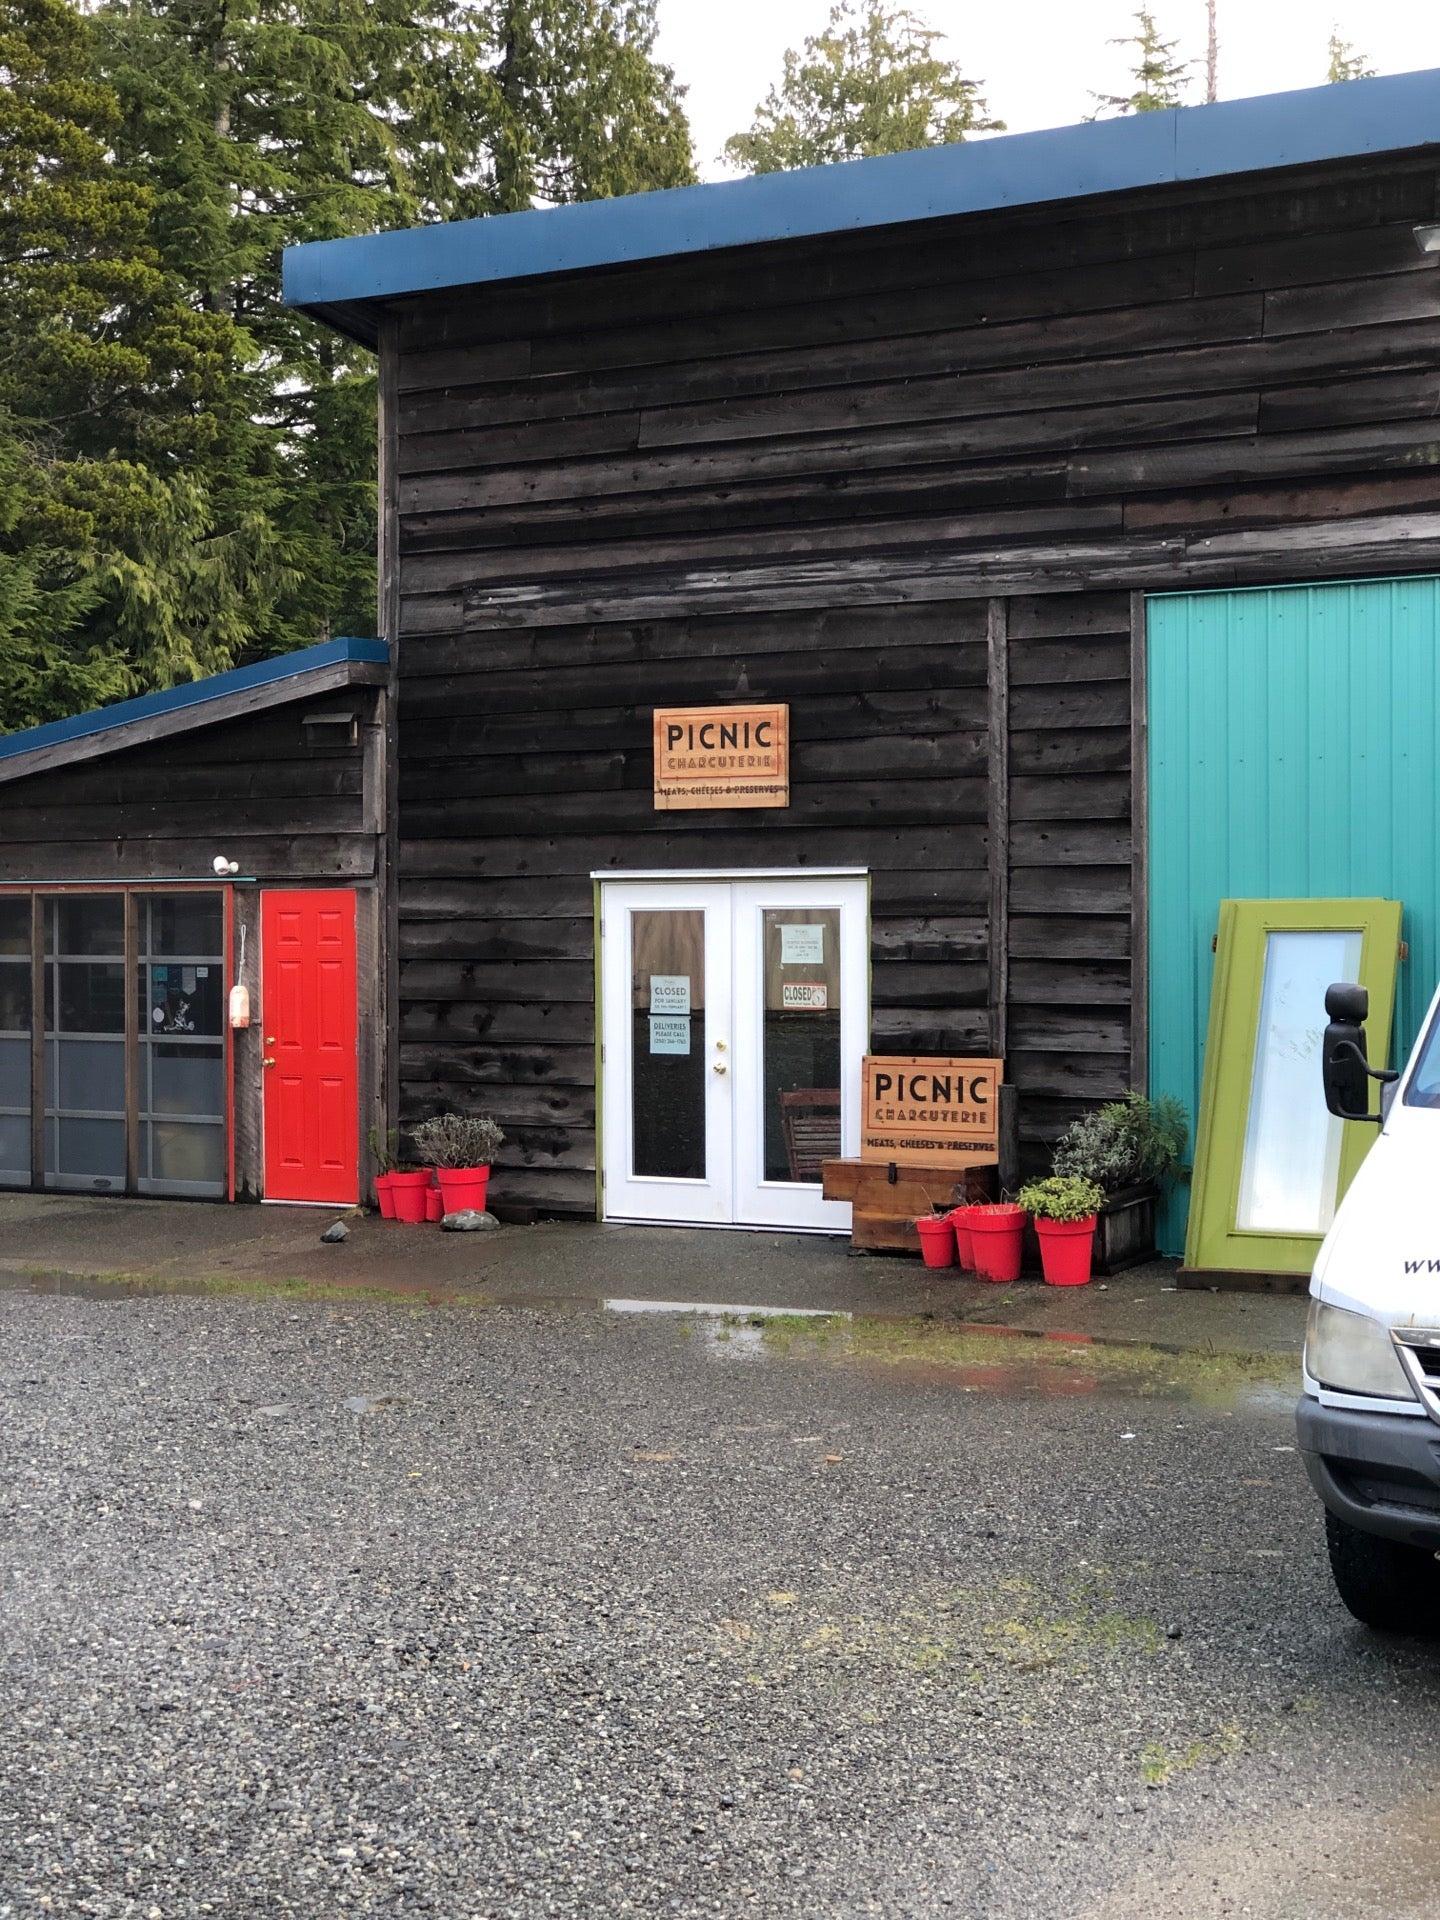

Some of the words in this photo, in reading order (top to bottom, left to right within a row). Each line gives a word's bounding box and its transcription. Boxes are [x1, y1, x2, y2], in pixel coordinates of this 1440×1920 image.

[667, 722, 771, 750] PICNIC
[667, 755, 771, 769] CHARCUTERIE
[660, 786, 689, 796] MEATS,
[690, 786, 723, 795] CHEESES
[735, 785, 779, 794] PRESERVES
[655, 987, 687, 996] CLOSED
[784, 986, 812, 1001] CLOSED
[875, 1073, 988, 1104] PICNIC
[875, 1108, 987, 1124] CHARCUTERIE
[867, 1138, 897, 1149] MEATS,
[900, 1139, 934, 1149] CHEESES
[947, 1141, 996, 1152] PRESERVES
